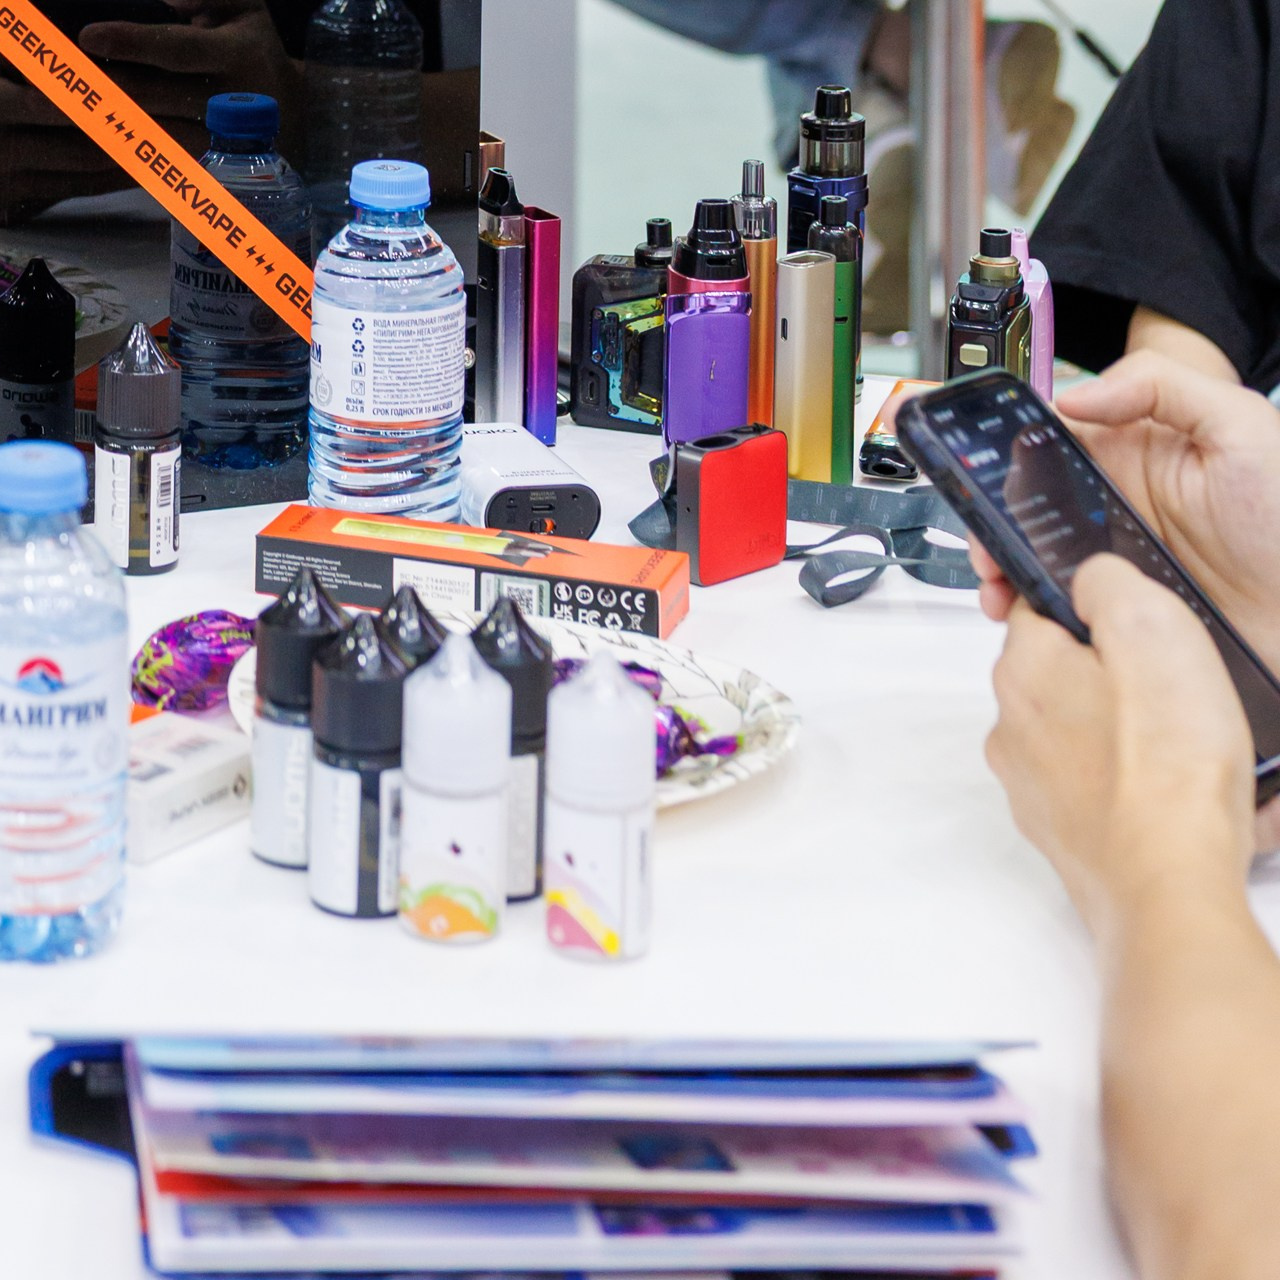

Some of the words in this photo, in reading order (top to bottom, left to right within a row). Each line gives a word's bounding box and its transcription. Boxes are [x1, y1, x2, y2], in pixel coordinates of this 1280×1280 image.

[134, 139, 247, 249] GEEKVAPE
[372, 407, 390, 417] СРОК
[390, 405, 424, 417] ГОДНОСТИ
[620, 590, 646, 613] CE
